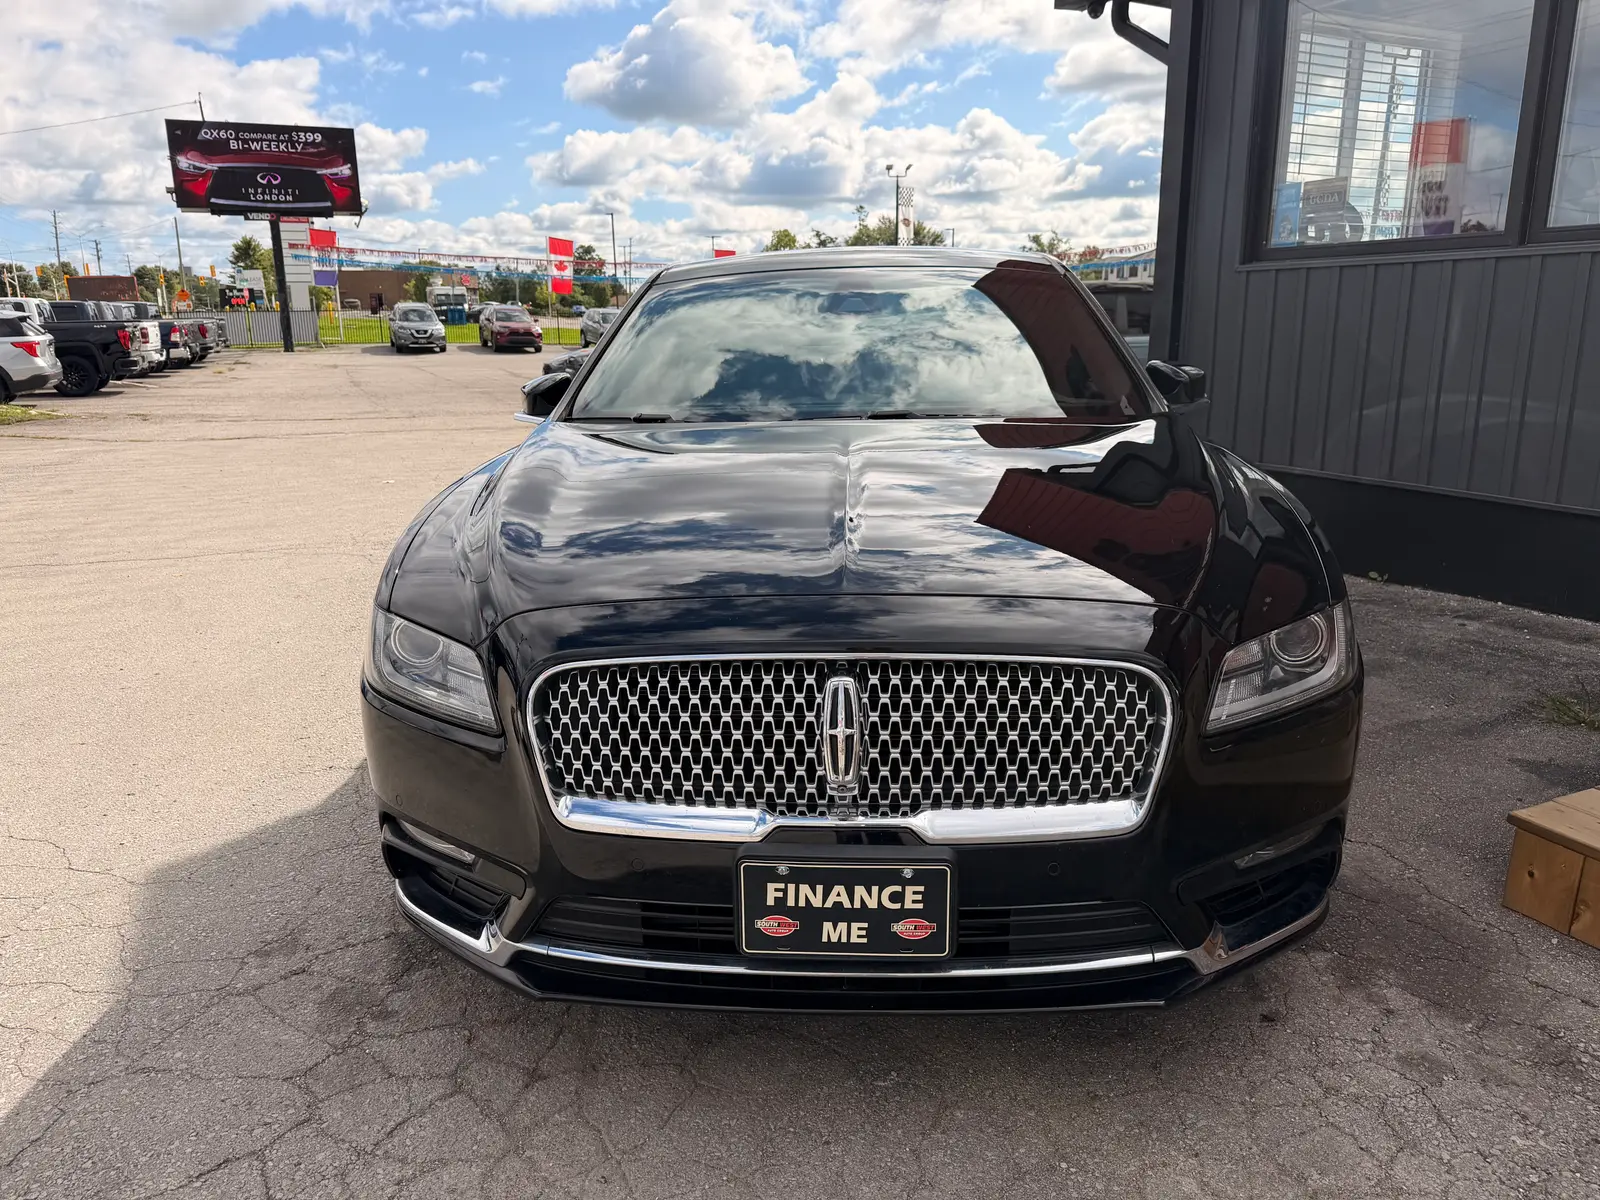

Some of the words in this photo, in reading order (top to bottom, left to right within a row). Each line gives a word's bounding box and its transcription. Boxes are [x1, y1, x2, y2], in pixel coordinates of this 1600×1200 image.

[201, 129, 235, 140] QX60
[238, 132, 277, 140] COMPARE
[291, 131, 322, 143] $399
[229, 140, 303, 152] BI-WEEKLY
[241, 187, 299, 195] INFINITI
[247, 212, 277, 220] VENDO
[766, 882, 925, 909] FINANCE
[821, 922, 869, 943] ME
